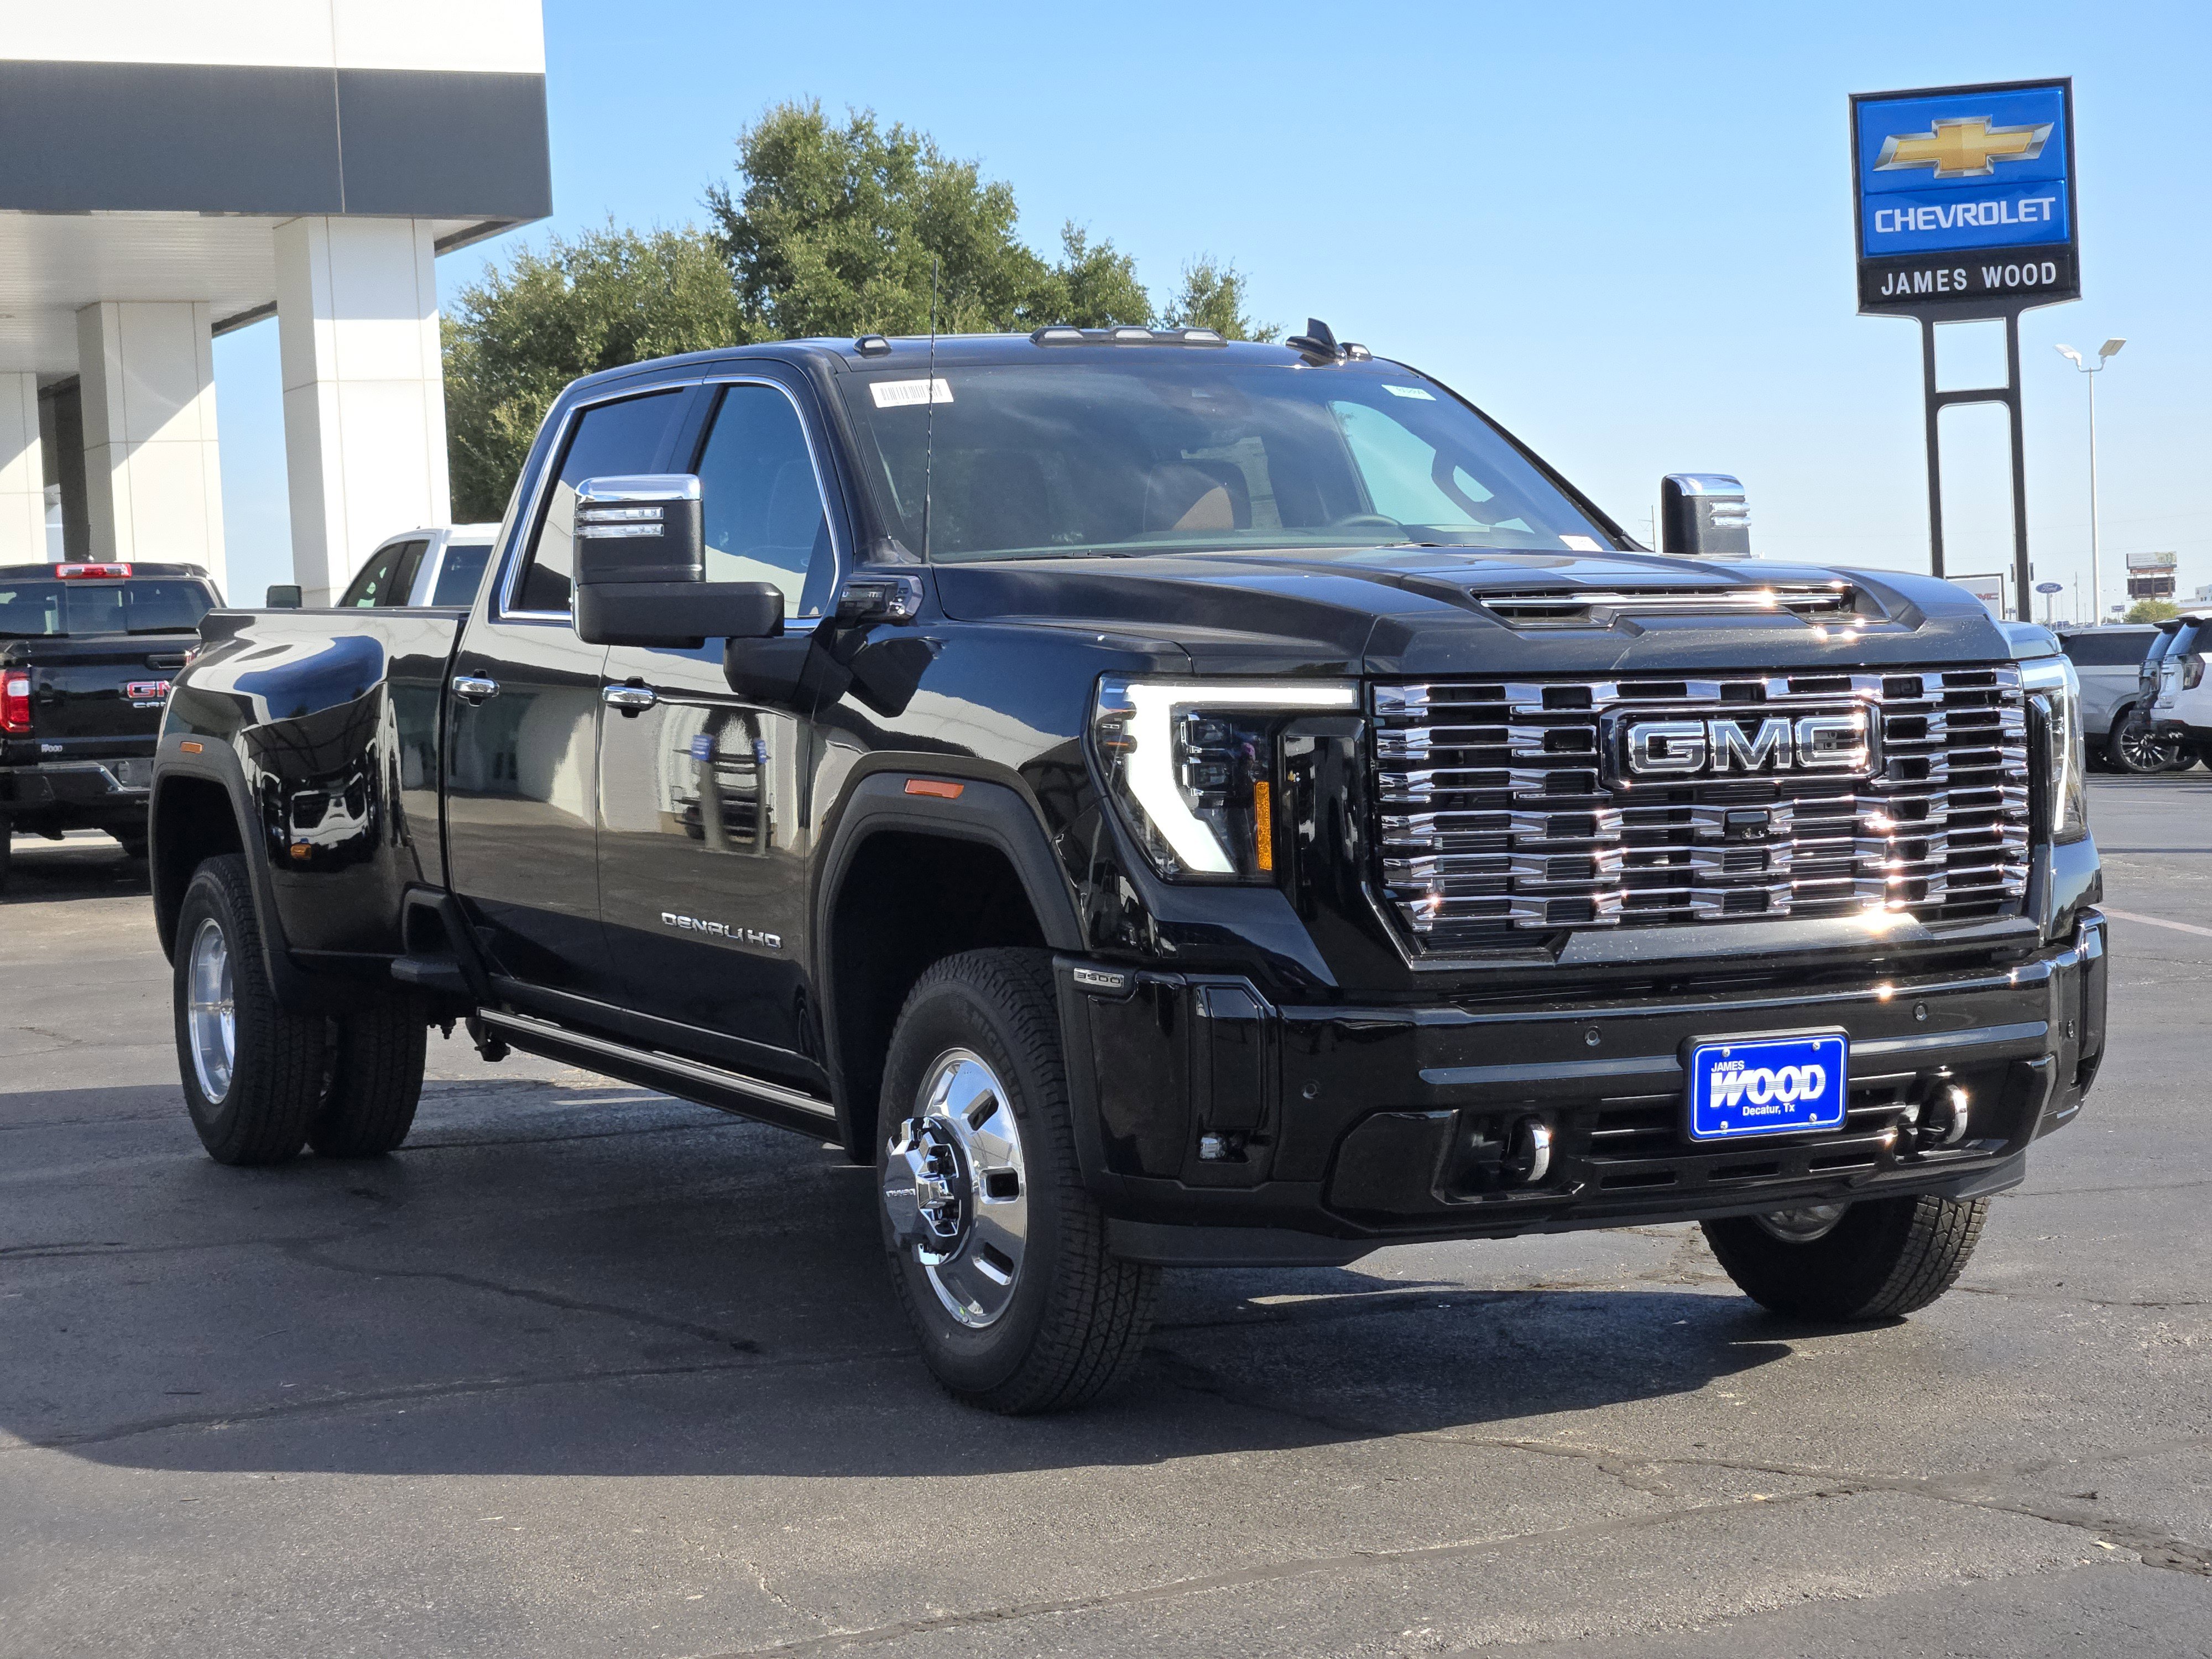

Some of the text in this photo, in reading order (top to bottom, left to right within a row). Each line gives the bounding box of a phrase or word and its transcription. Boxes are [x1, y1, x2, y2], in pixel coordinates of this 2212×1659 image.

[1875, 197, 2056, 232] CHEVROLET
[1881, 262, 2057, 295] JAMES WOOD
[1627, 716, 1866, 774] GMC
[661, 912, 781, 948] DENALI HD
[1076, 972, 1121, 984] 3500
[1711, 1060, 1745, 1073] JAMES
[1709, 1064, 1826, 1108] WOOD
[1743, 1102, 1795, 1117] Decatur, Tx
